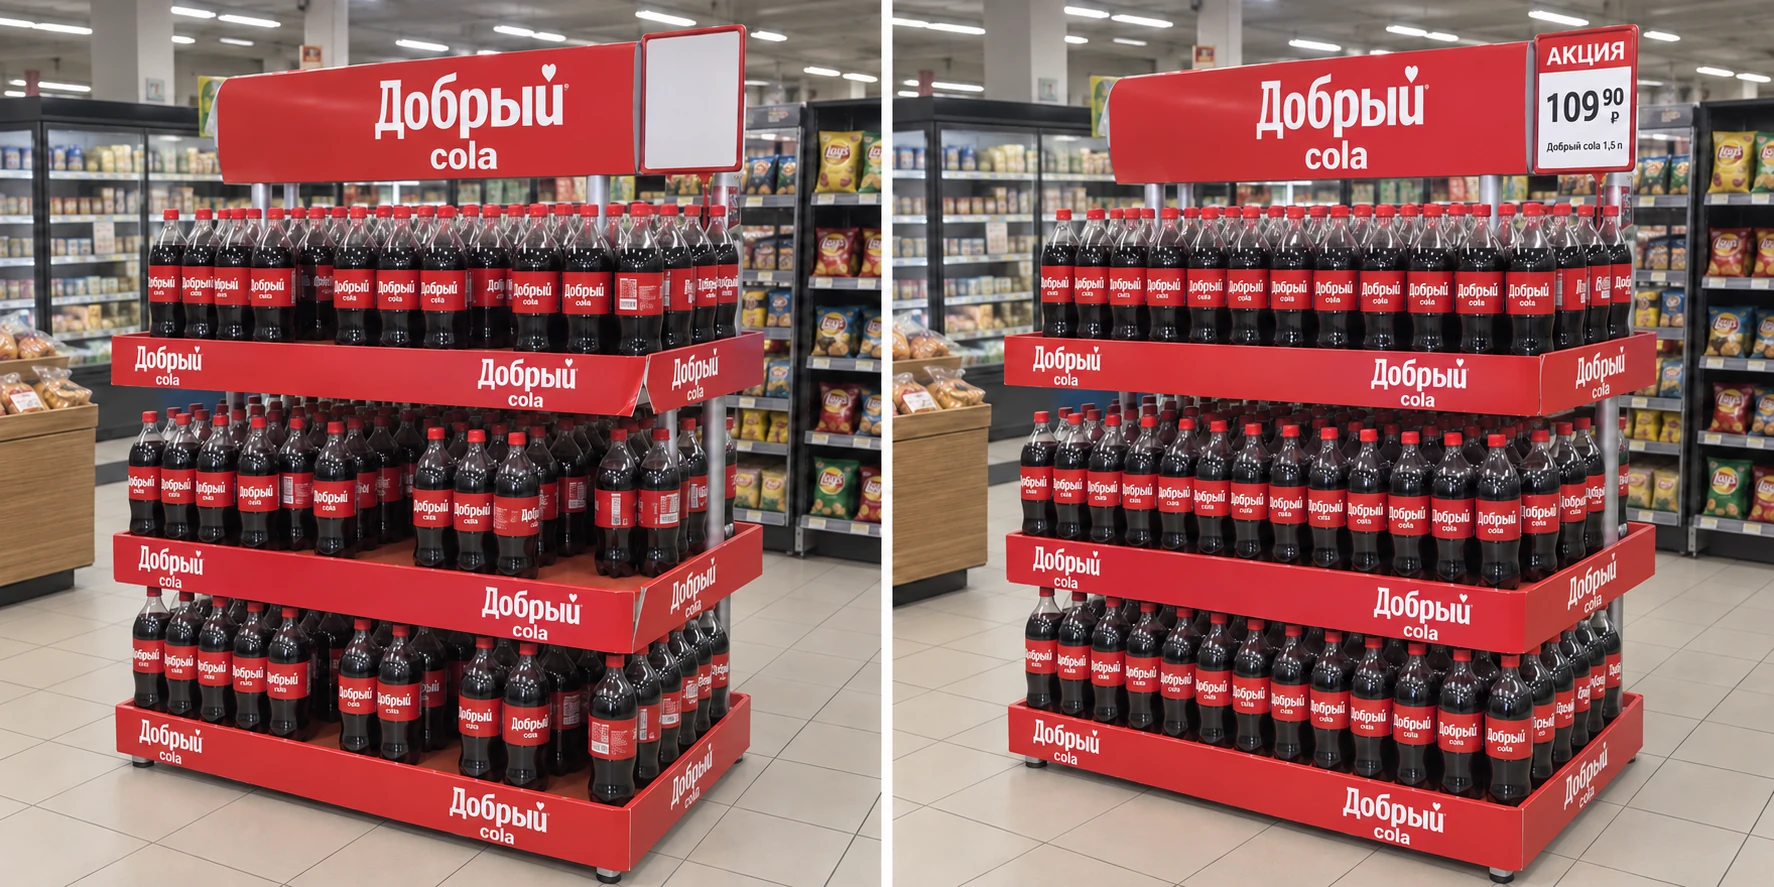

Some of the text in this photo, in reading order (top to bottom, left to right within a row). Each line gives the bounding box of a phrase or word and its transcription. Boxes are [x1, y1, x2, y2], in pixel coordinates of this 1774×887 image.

[1546, 41, 1624, 66] АКЦИЯ
[375, 63, 564, 140] Добрый
[1256, 65, 1425, 140] Добрый
[1547, 87, 1624, 122] 109 90
[430, 141, 498, 170] cola
[1305, 140, 1368, 170] cola
[1546, 141, 1581, 153] Добрый
[1583, 141, 1601, 150] cola
[1603, 141, 1616, 151] 1,5
[135, 346, 202, 373] Добрый
[672, 348, 719, 390] Добрый
[1033, 346, 1101, 373] Добрый
[1576, 346, 1625, 389] Добрый
[155, 373, 180, 386] cola
[477, 358, 576, 392] Добрый
[1054, 373, 1078, 386] cola
[1371, 358, 1467, 392] Добрый
[508, 392, 543, 408] cola
[687, 385, 704, 401] cola
[1400, 392, 1435, 407] cola
[1592, 383, 1610, 399] cola
[138, 545, 203, 576] Добрый
[1033, 546, 1100, 576] Добрый
[159, 575, 182, 588] cola
[670, 557, 716, 614] Добрый
[1054, 575, 1078, 589] cola
[1567, 552, 1617, 610] Добрый
[481, 586, 580, 625] Добрый
[685, 599, 702, 618] cola
[1373, 586, 1470, 625] Добрый
[1584, 594, 1602, 613] cola
[512, 624, 548, 640] cola
[1403, 624, 1439, 640] cola
[138, 719, 203, 754] Добрый
[1033, 719, 1100, 754] Добрый
[159, 751, 183, 765] cola
[1054, 751, 1078, 766] cola
[671, 743, 713, 810] Добрый
[1564, 742, 1608, 810] Добрый
[449, 786, 547, 833] Добрый
[684, 787, 700, 809] cola
[1343, 787, 1444, 834] Добрый
[479, 827, 515, 845] cola
[1374, 827, 1411, 845] cola
